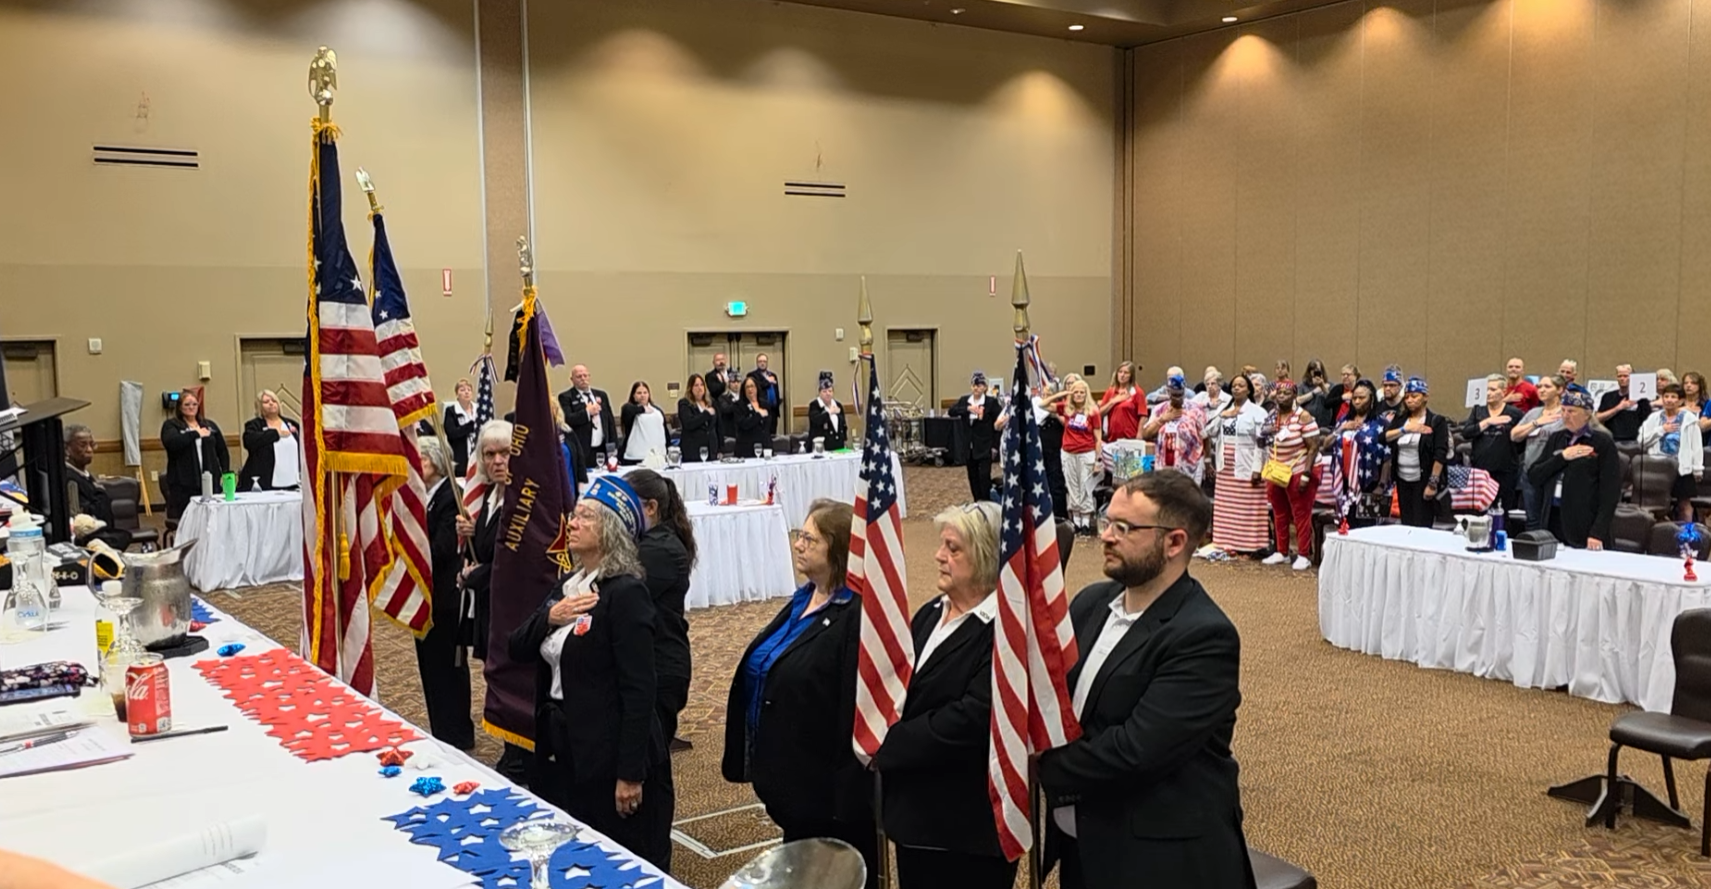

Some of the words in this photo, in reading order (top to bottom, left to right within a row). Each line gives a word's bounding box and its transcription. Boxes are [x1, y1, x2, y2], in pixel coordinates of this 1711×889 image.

[1474, 387, 1481, 401] 3
[1639, 381, 1647, 394] 2
[511, 423, 530, 456] OHIO
[505, 477, 540, 552] AUXILIARY
